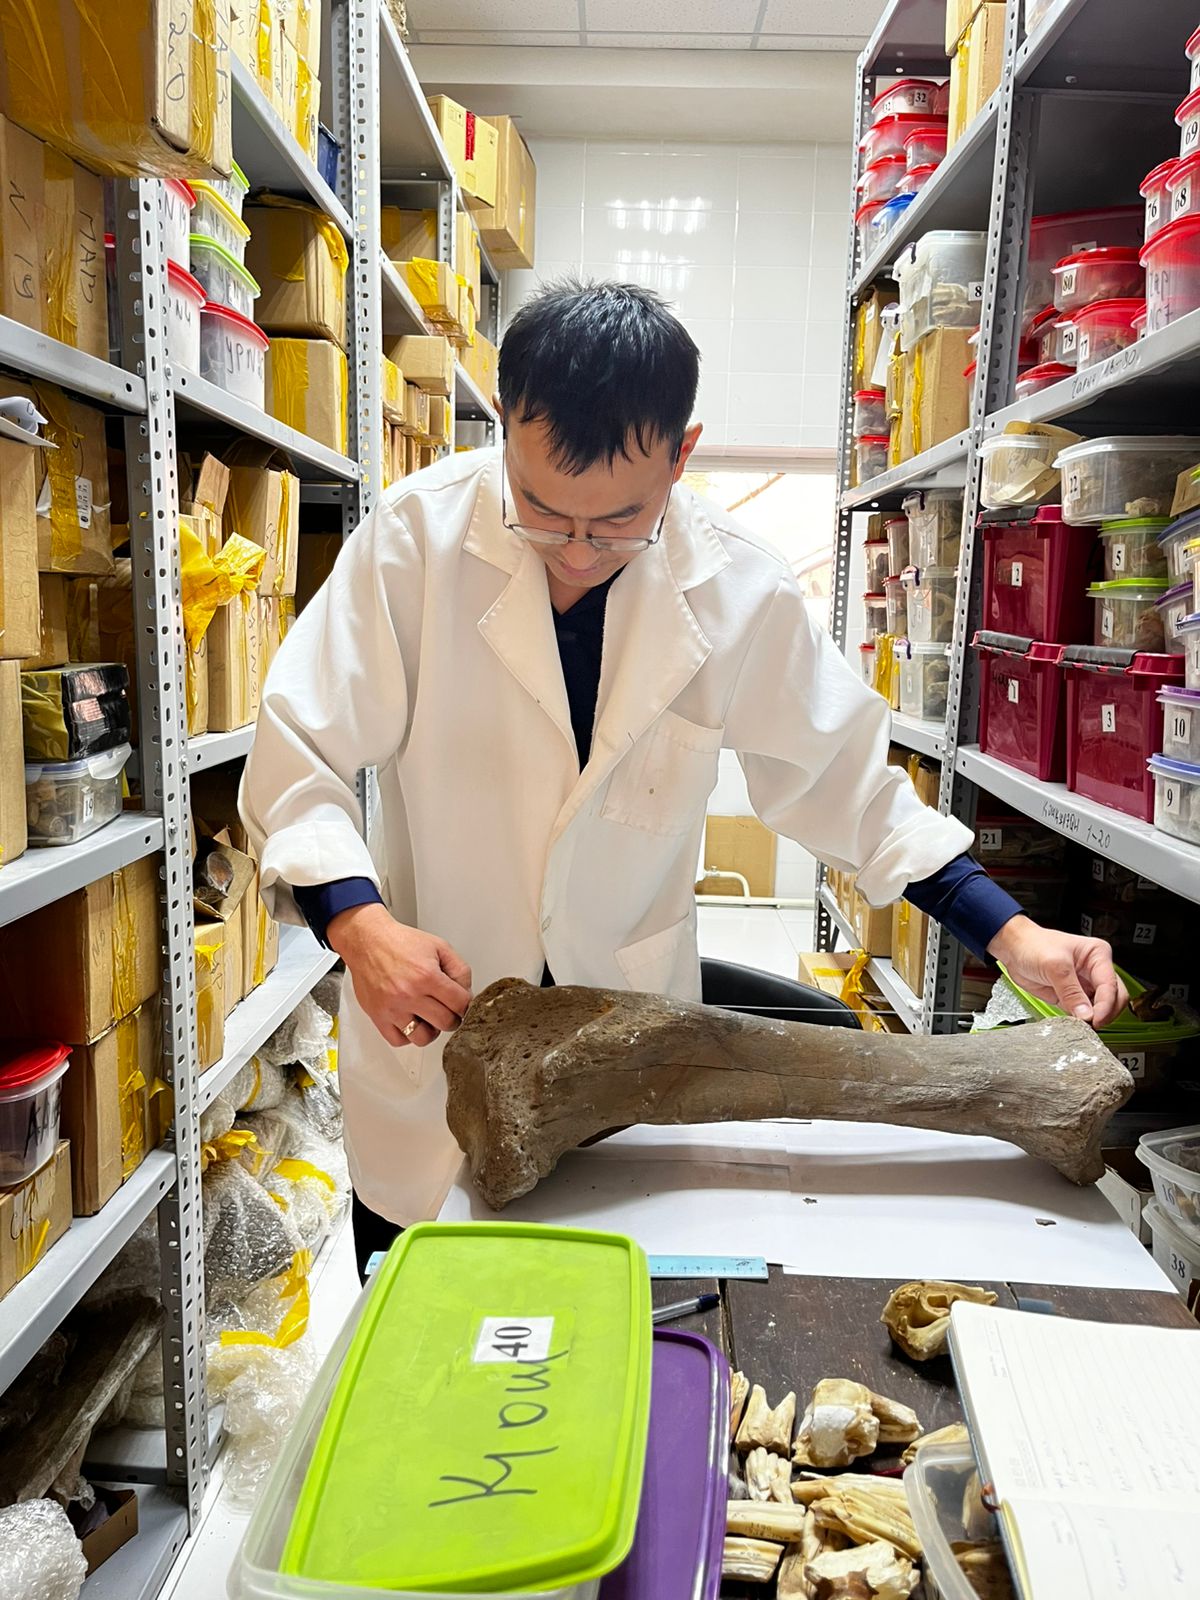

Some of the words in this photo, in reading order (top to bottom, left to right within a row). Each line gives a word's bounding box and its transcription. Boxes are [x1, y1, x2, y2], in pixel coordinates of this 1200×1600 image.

[915, 92, 926, 102] 32
[1185, 120, 1198, 145] 69
[1174, 187, 1187, 212] 68
[1147, 199, 1157, 218] 76
[1062, 274, 1073, 290] 80
[1063, 331, 1074, 349] 79
[1115, 550, 1122, 567] 5
[1015, 567, 1020, 582] 2
[1103, 617, 1109, 632] 4
[1106, 711, 1112, 728] 3
[1174, 717, 1186, 737] 10
[1167, 790, 1173, 807] 9
[981, 832, 996, 846] 21
[1136, 927, 1151, 939] 22
[1161, 1184, 1175, 1204] 16
[1171, 1253, 1185, 1278] 38
[491, 1325, 532, 1358] 40
